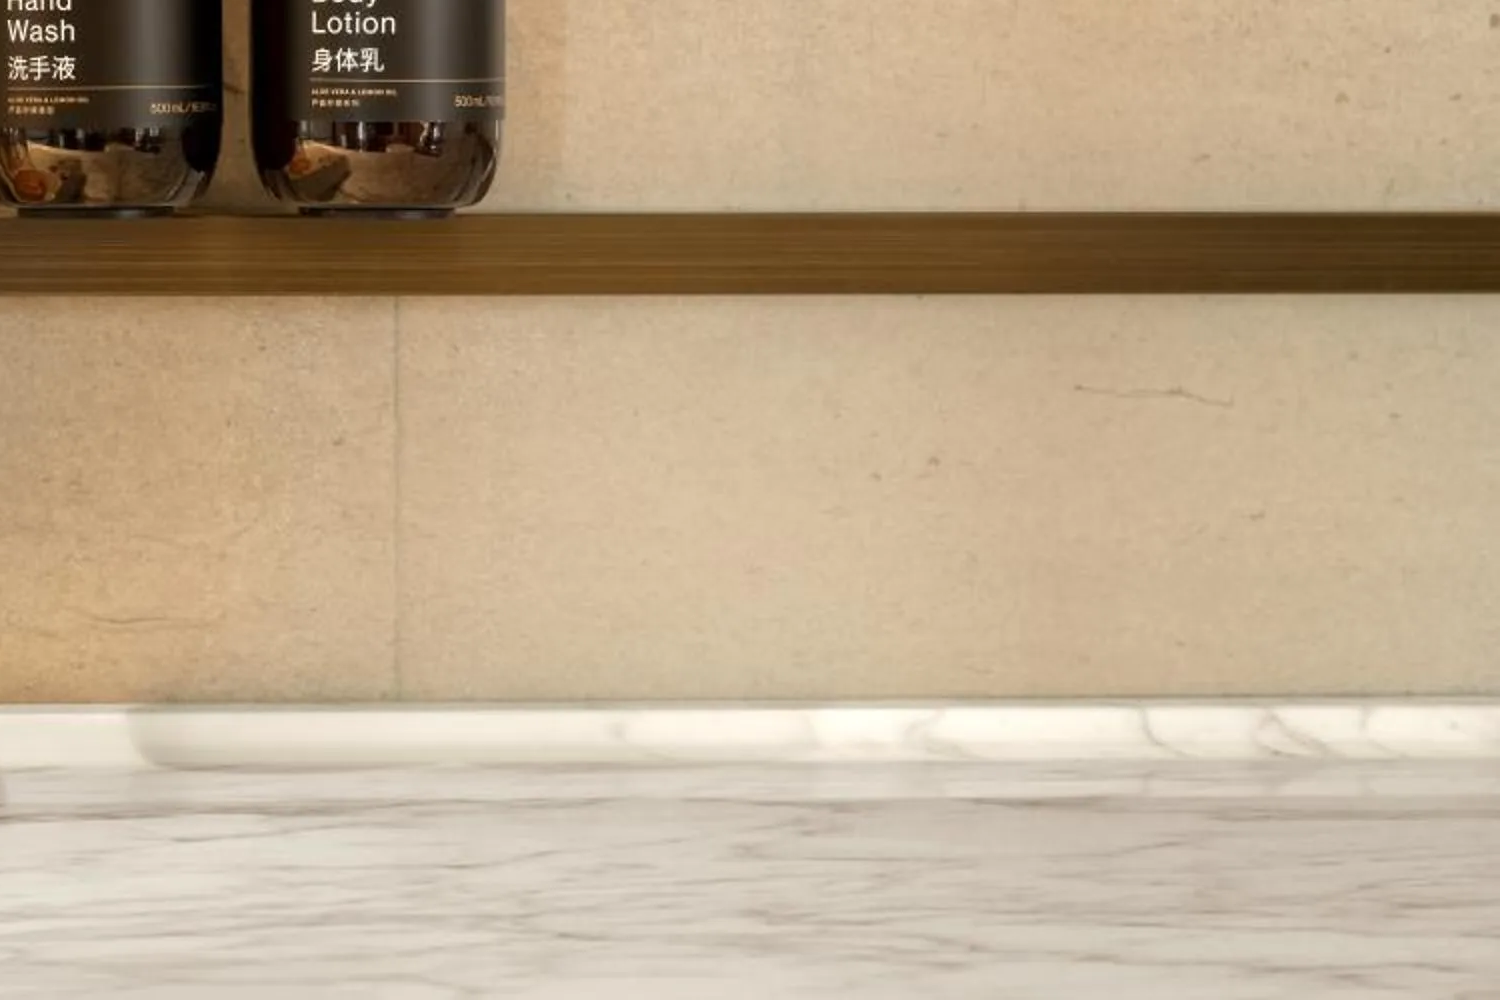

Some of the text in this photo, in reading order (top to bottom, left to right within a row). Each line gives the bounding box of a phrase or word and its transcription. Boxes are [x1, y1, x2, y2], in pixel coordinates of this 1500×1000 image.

[7, 19, 75, 42] Wash
[311, 11, 396, 35] Lotion
[7, 55, 76, 81] 洗手液
[311, 47, 385, 73] 身体乳
